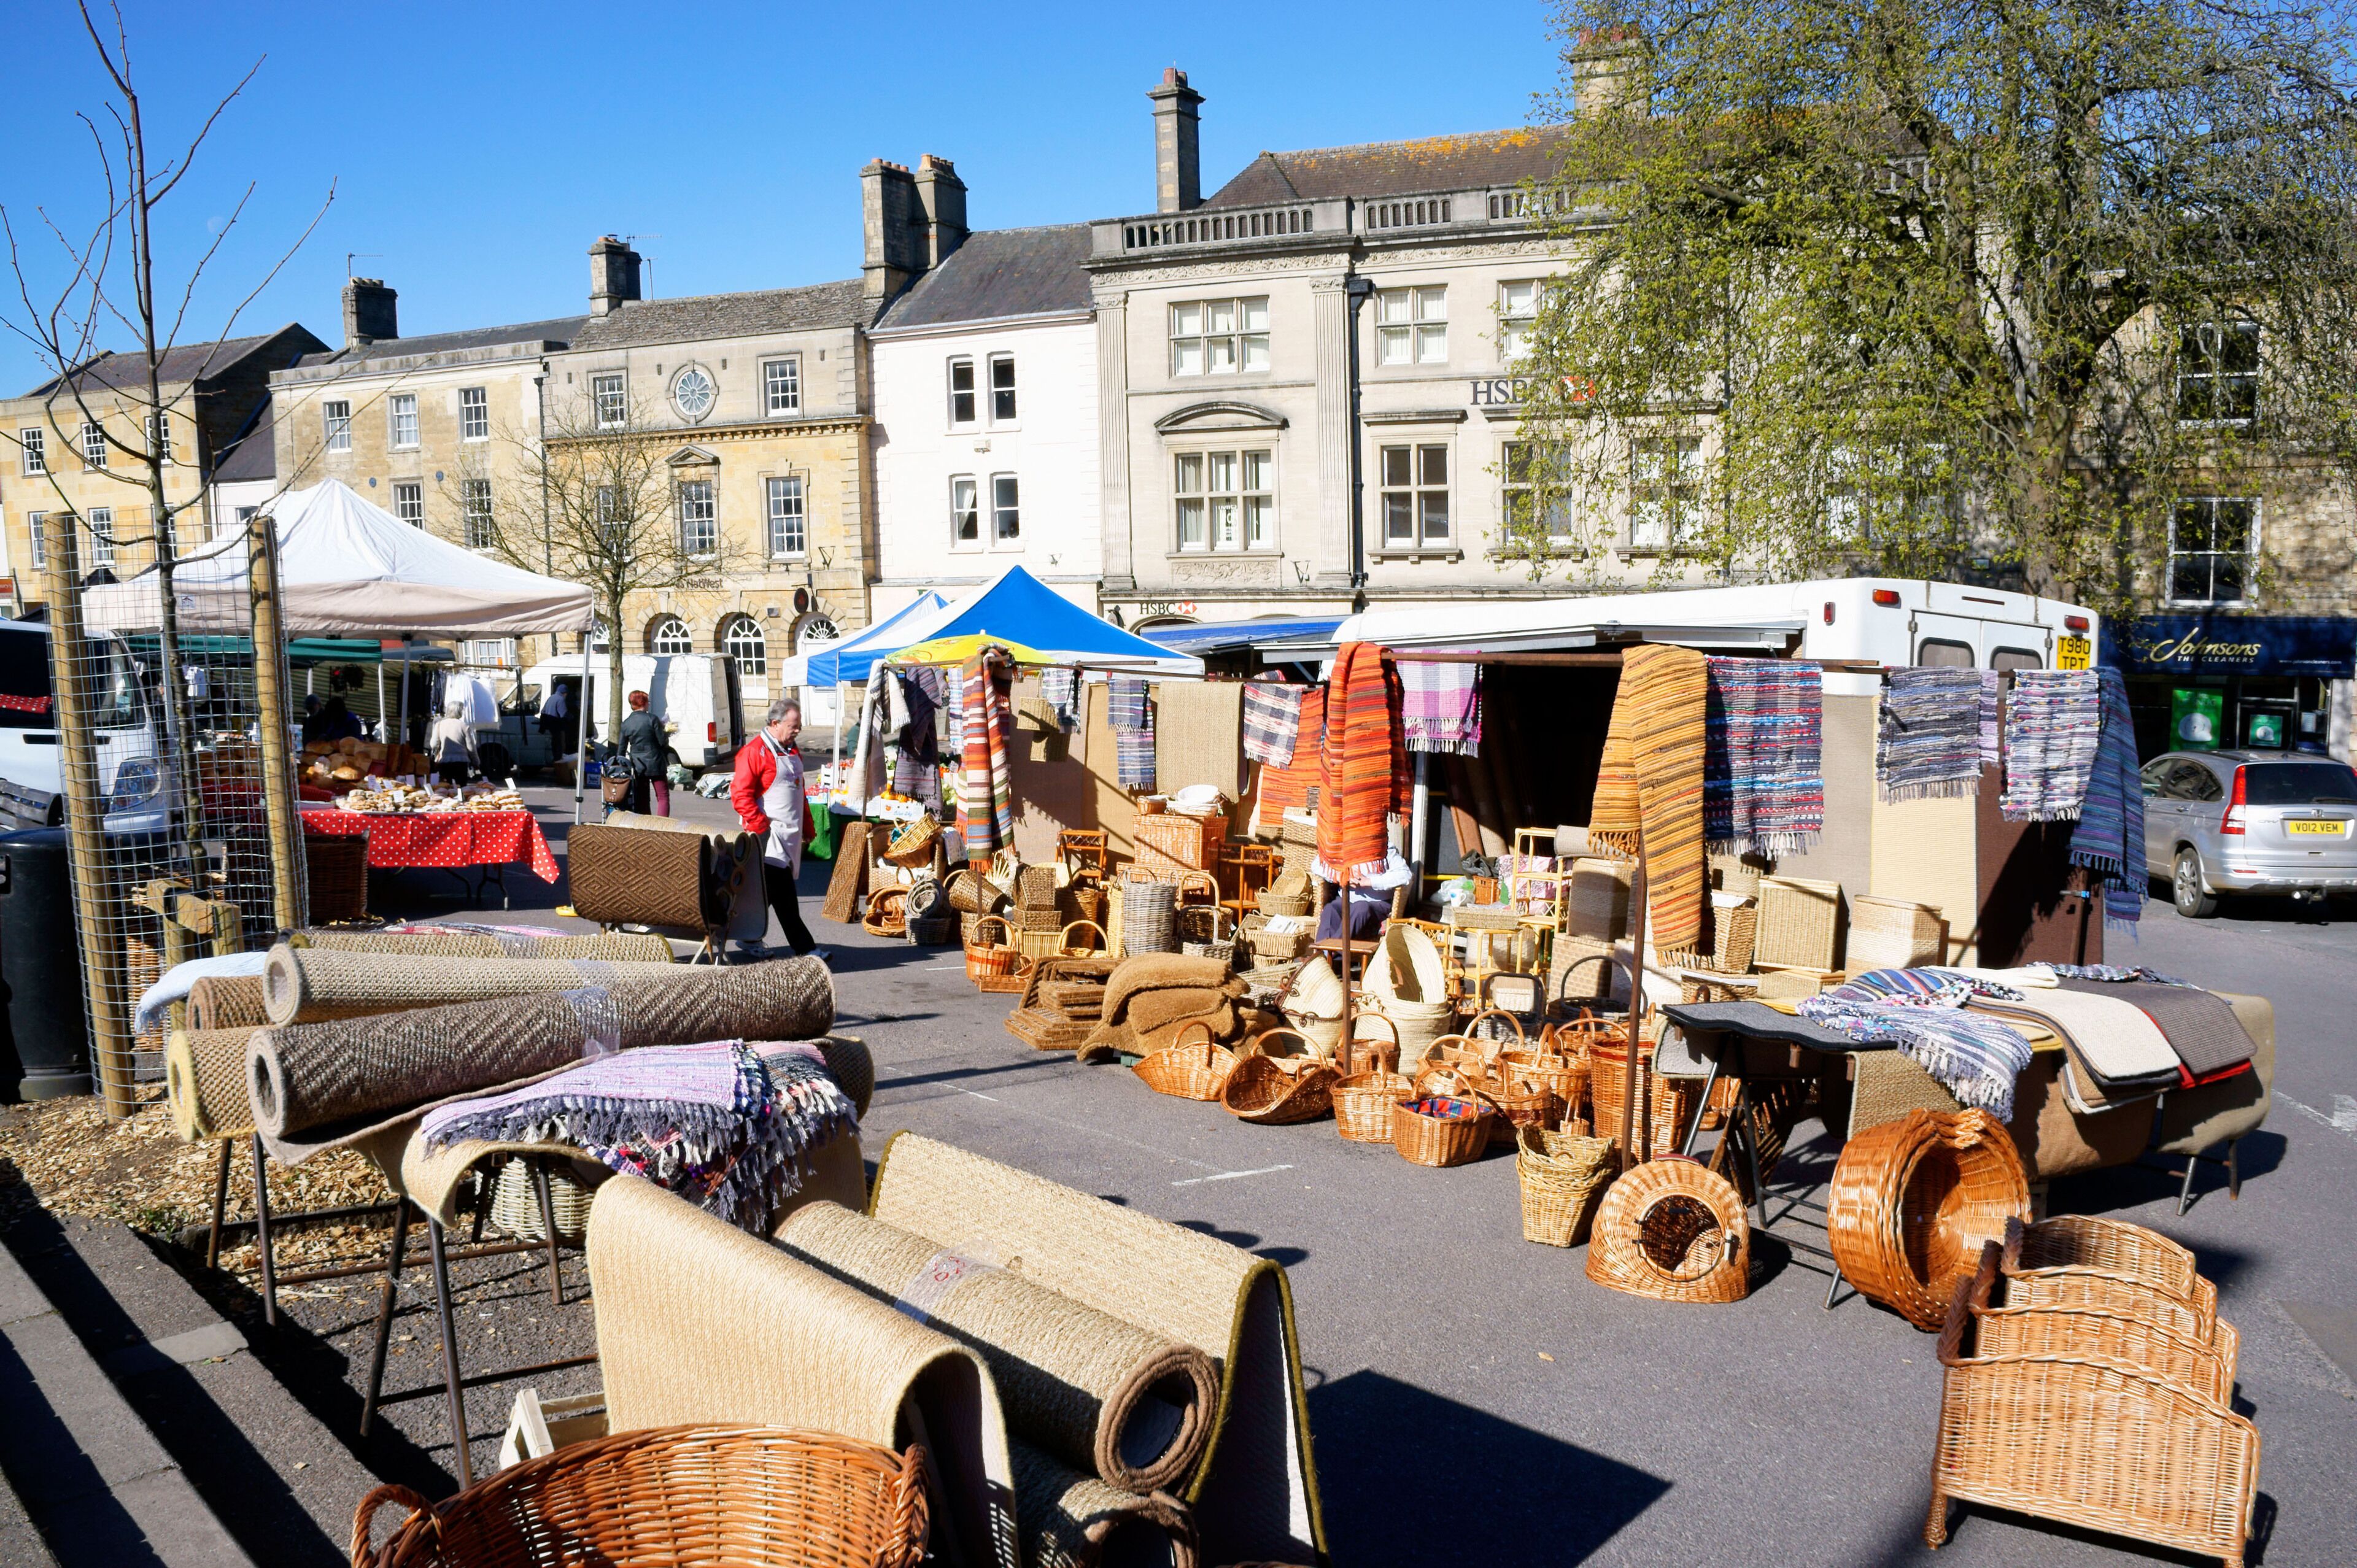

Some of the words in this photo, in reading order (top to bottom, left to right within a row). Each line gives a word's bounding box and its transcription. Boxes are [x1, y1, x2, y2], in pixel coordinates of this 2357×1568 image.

[1470, 379, 1529, 405] HSB
[687, 578, 723, 589] NatWest
[1139, 602, 1176, 615] HSBC
[2060, 637, 2091, 655] T980
[2150, 627, 2262, 662] Johnsons
[2062, 656, 2086, 670] TPT
[2296, 823, 2316, 832] VO12
[2320, 824, 2338, 832] VEM
